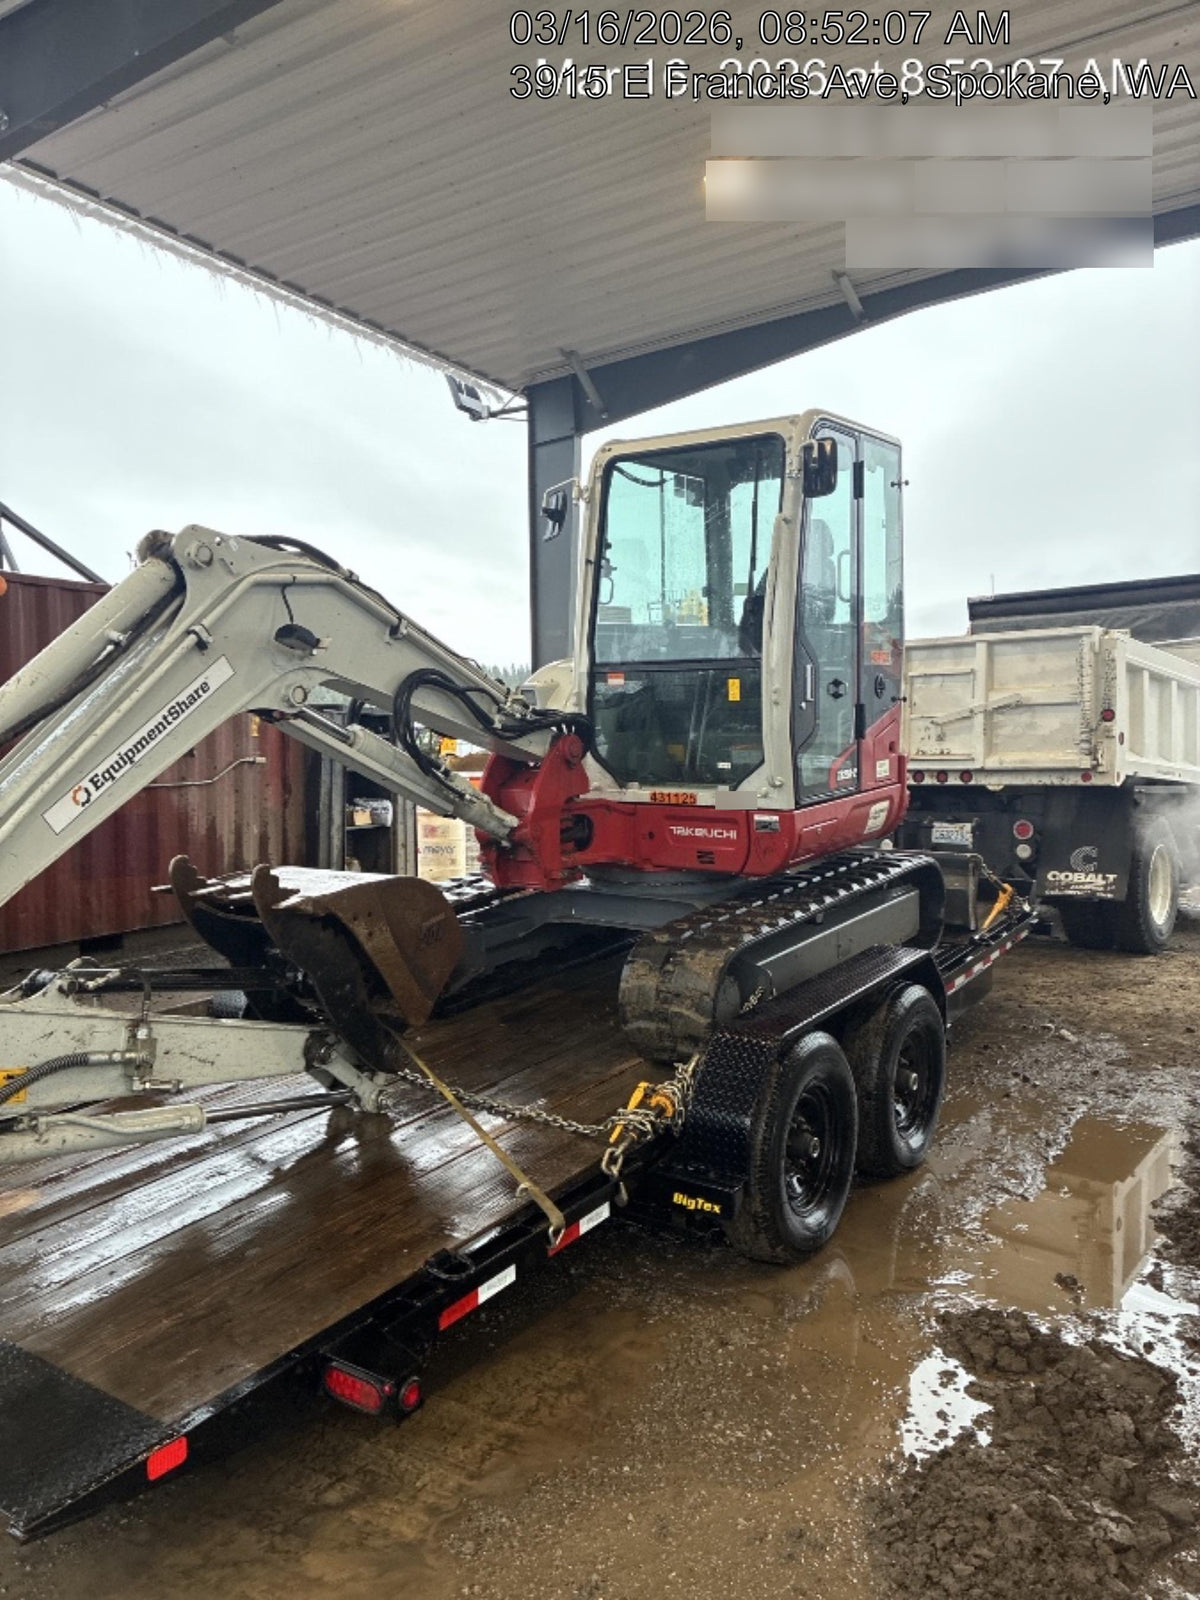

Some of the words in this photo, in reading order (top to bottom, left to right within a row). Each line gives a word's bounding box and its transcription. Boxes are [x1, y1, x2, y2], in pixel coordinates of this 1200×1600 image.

[88, 680, 211, 792] EquipmentShare
[649, 791, 698, 805] 431125
[669, 826, 737, 840] TAKEUCHI
[1046, 870, 1118, 886] COBALT
[673, 1192, 722, 1214] BigTex
